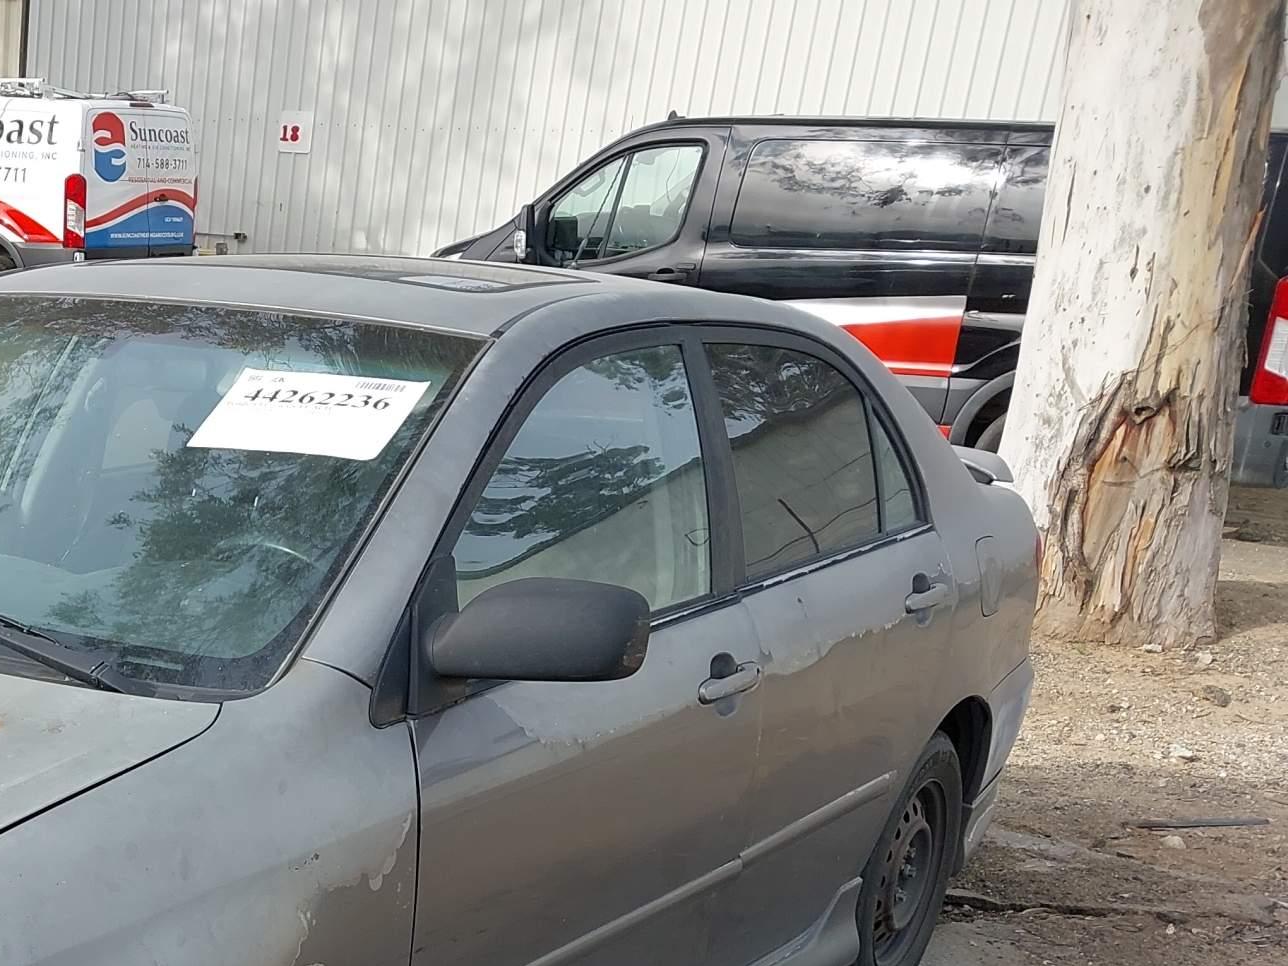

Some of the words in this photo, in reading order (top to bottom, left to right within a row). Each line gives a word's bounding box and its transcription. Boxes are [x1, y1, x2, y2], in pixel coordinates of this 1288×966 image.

[129, 120, 190, 144] Suncoast
[280, 125, 300, 142] 18
[41, 152, 57, 160] INC
[137, 157, 187, 170] 714-588-3711
[244, 388, 393, 410] 44262236
